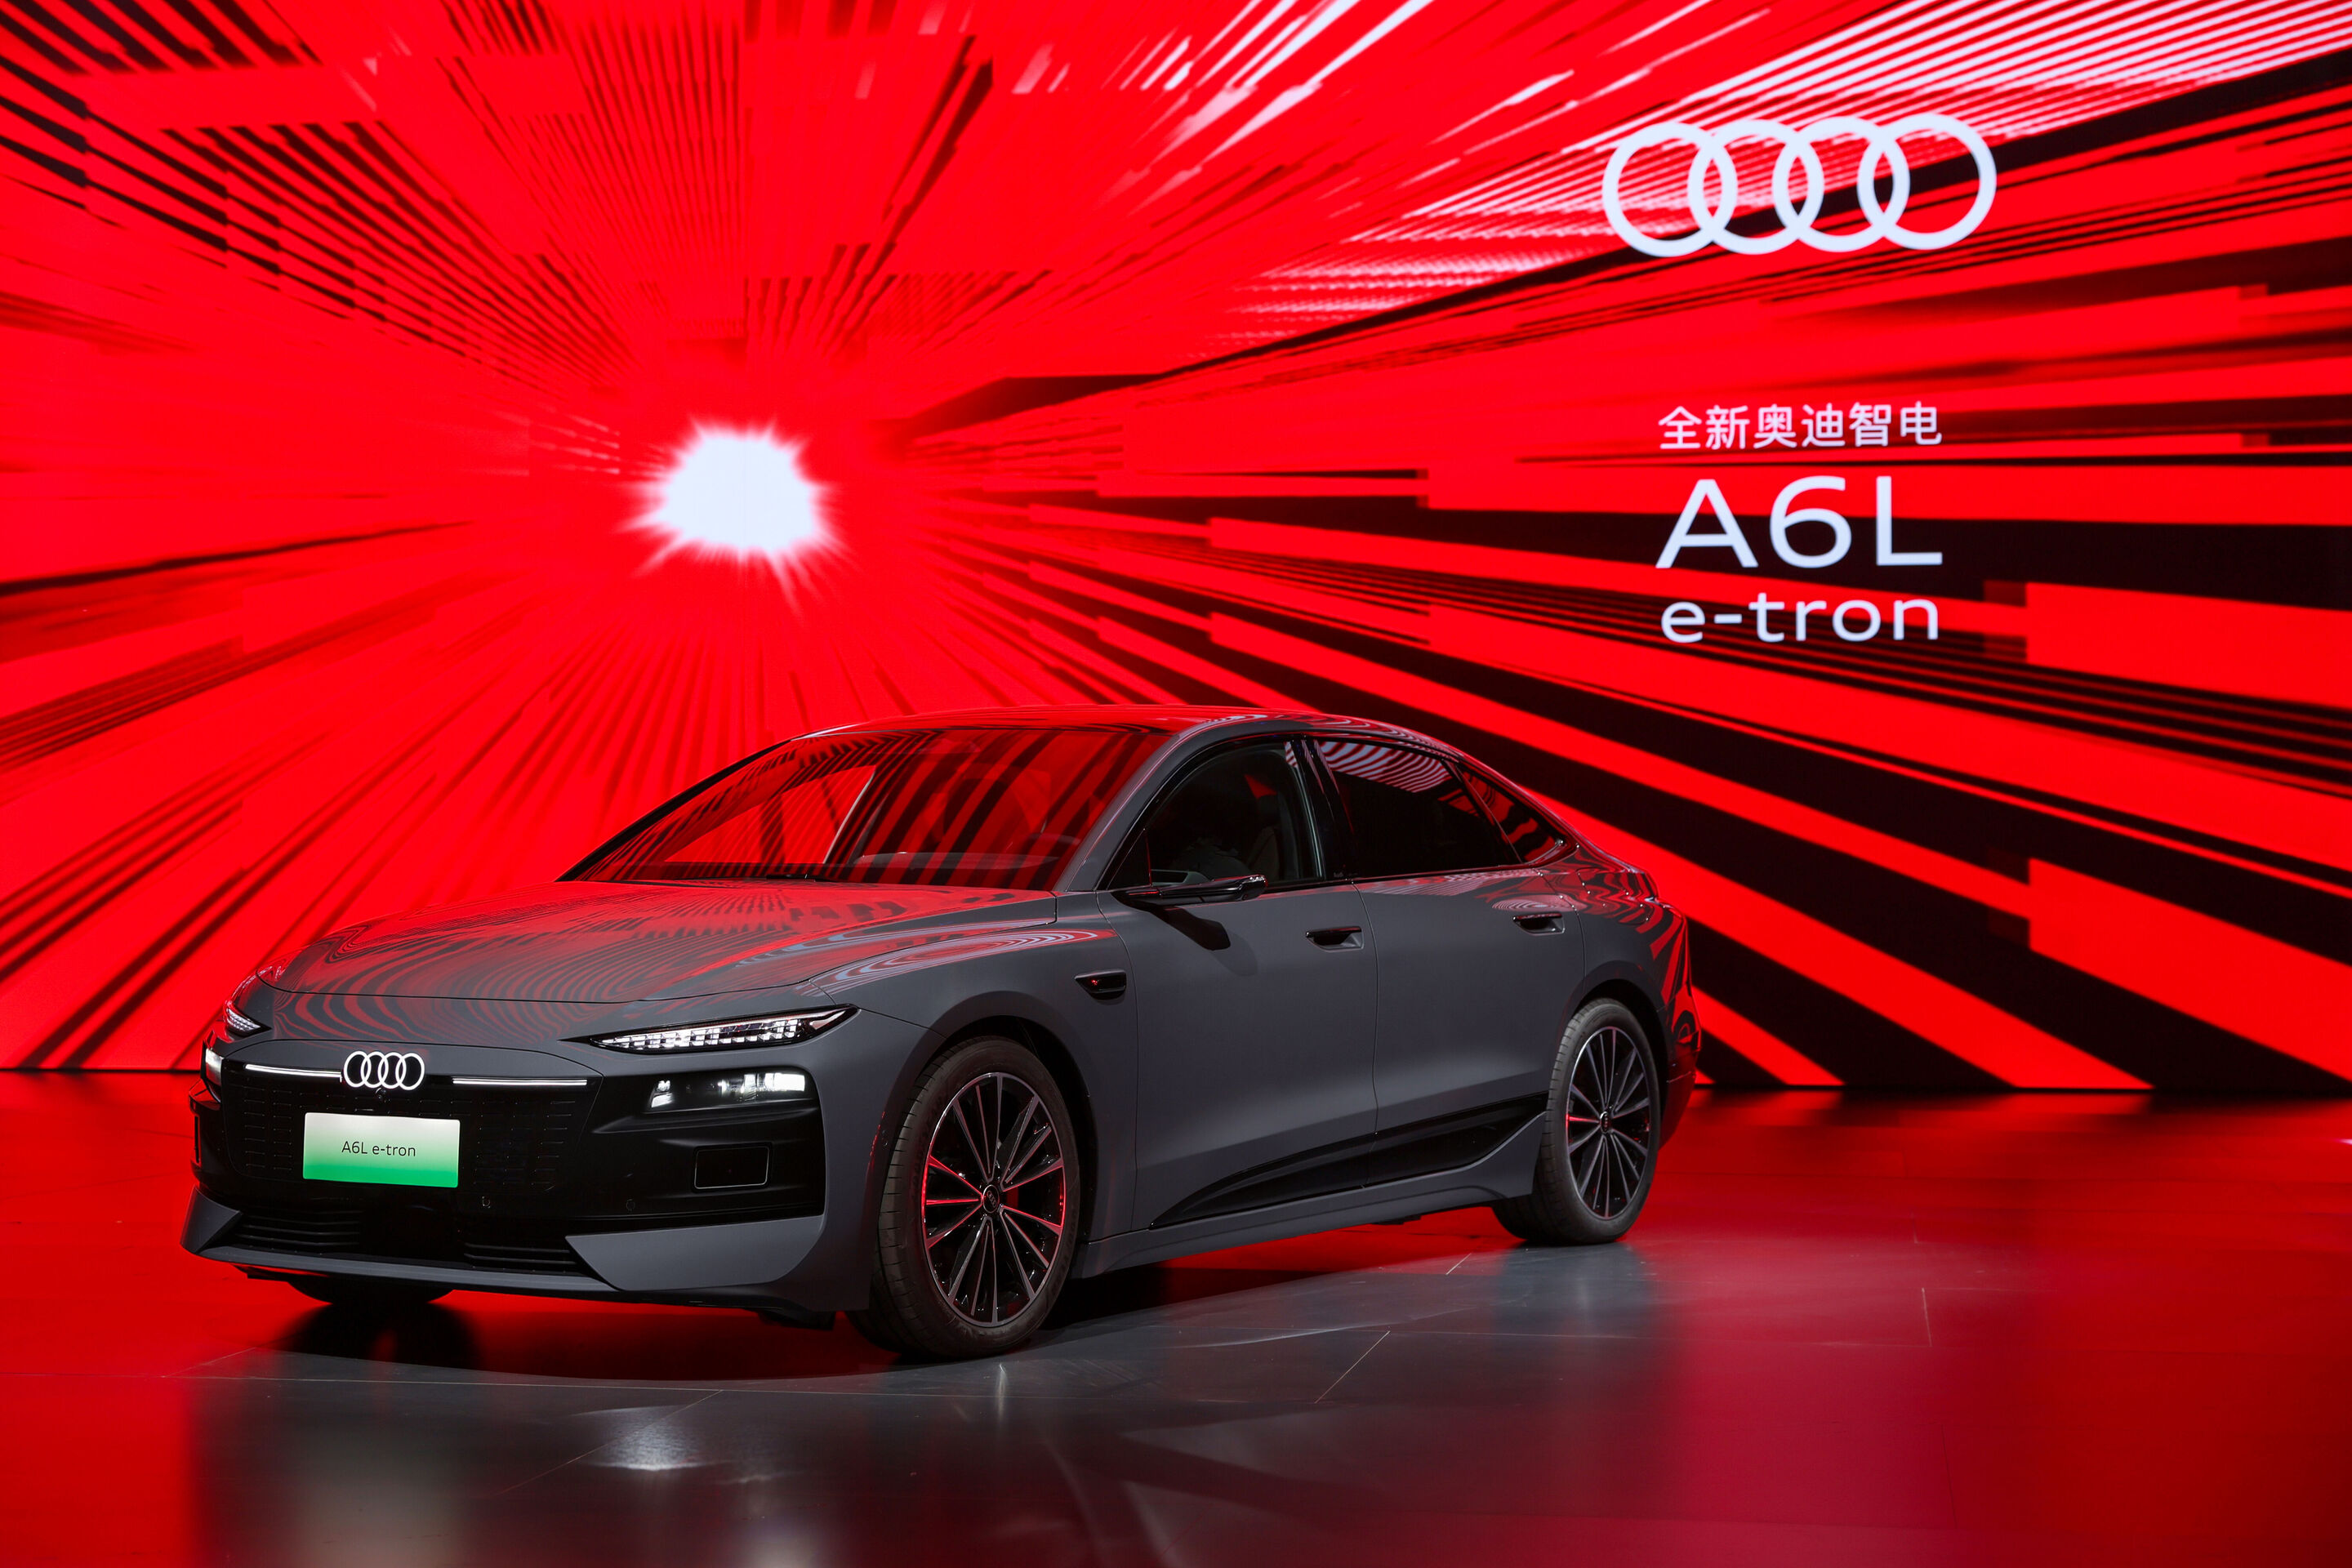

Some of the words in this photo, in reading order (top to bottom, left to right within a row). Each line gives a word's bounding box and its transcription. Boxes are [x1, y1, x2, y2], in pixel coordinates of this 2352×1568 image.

[1658, 401, 1943, 450] 全新奥迪智电
[1655, 475, 1944, 568] A6L
[1660, 592, 1939, 644] e-tron
[341, 1141, 368, 1154] A6L
[372, 1144, 416, 1156] e-tron
